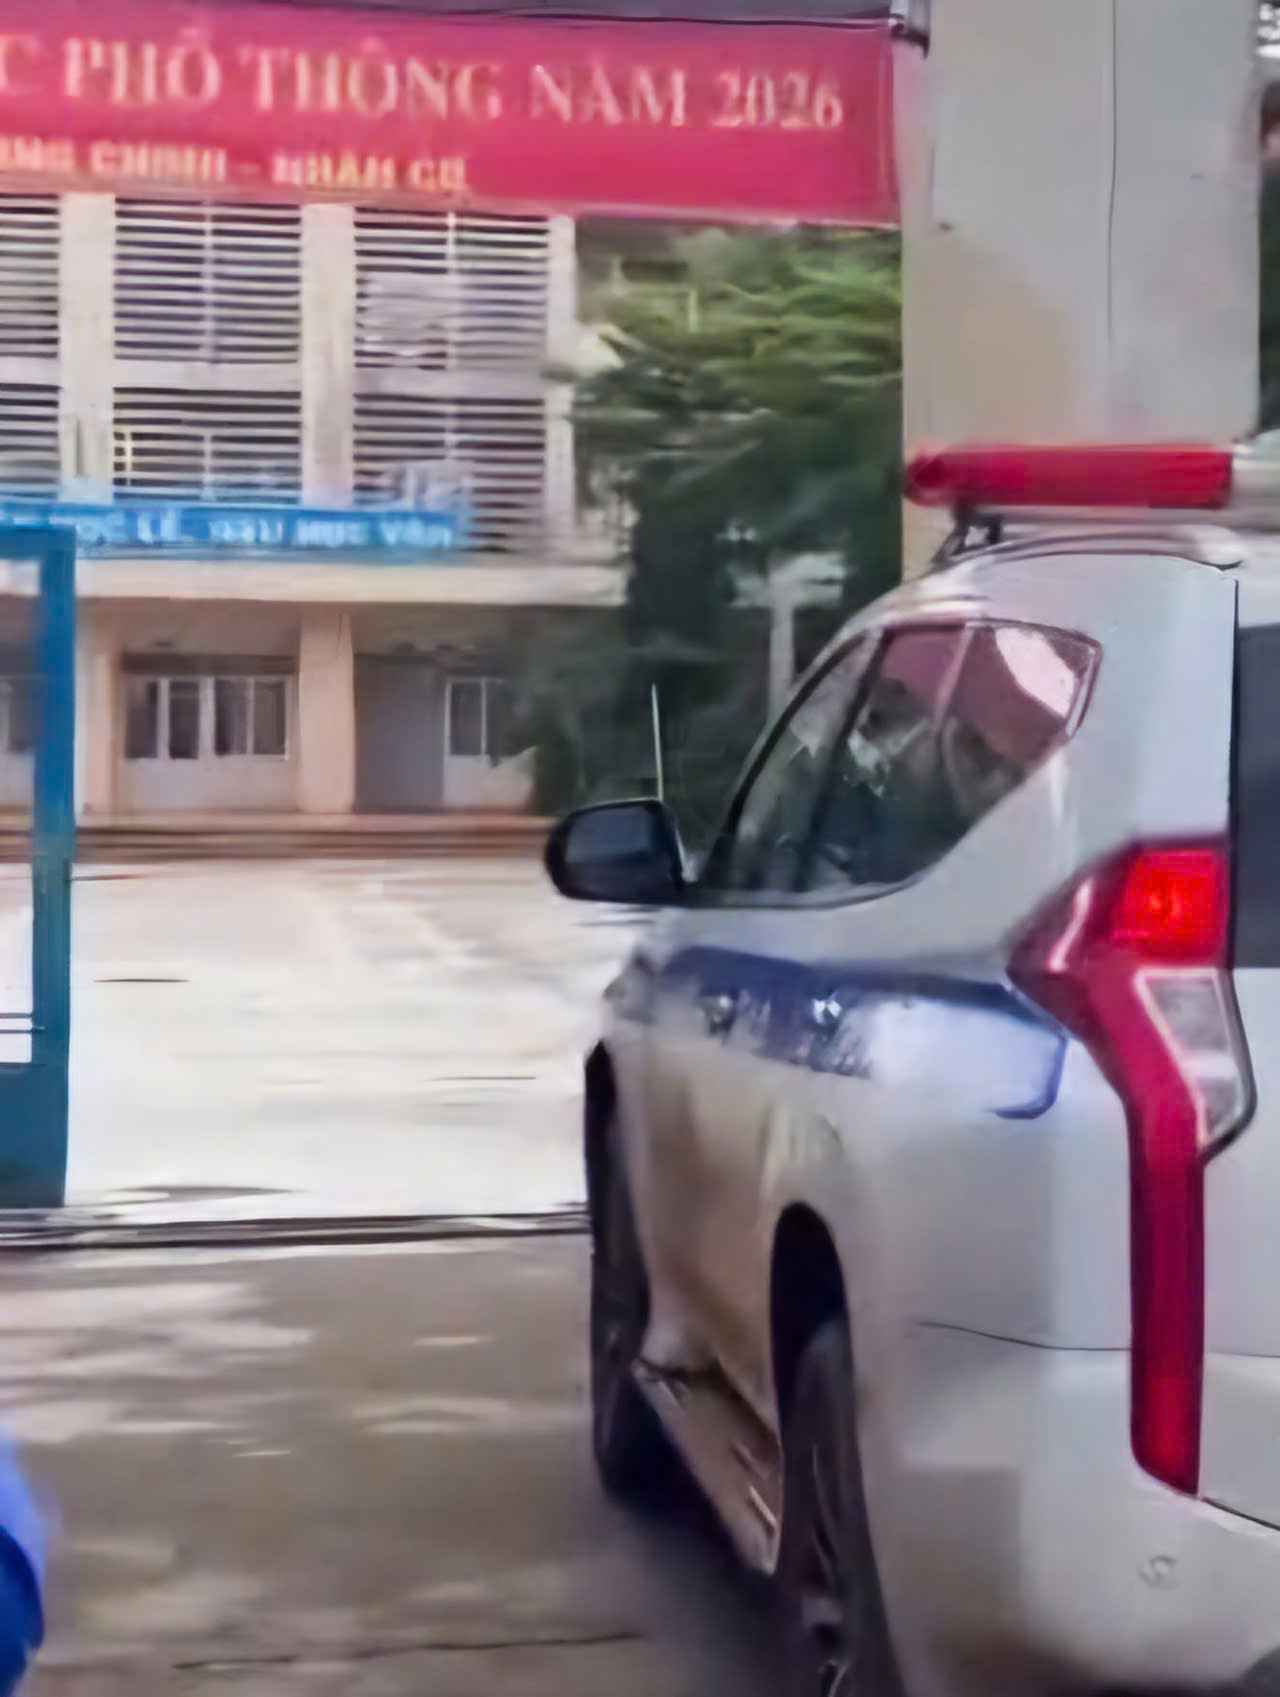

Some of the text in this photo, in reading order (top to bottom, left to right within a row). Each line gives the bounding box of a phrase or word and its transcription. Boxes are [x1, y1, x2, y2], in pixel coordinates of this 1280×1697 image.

[238, 38, 502, 122] THÔNG
[529, 50, 687, 127] NĂM
[711, 66, 843, 128] 2026
